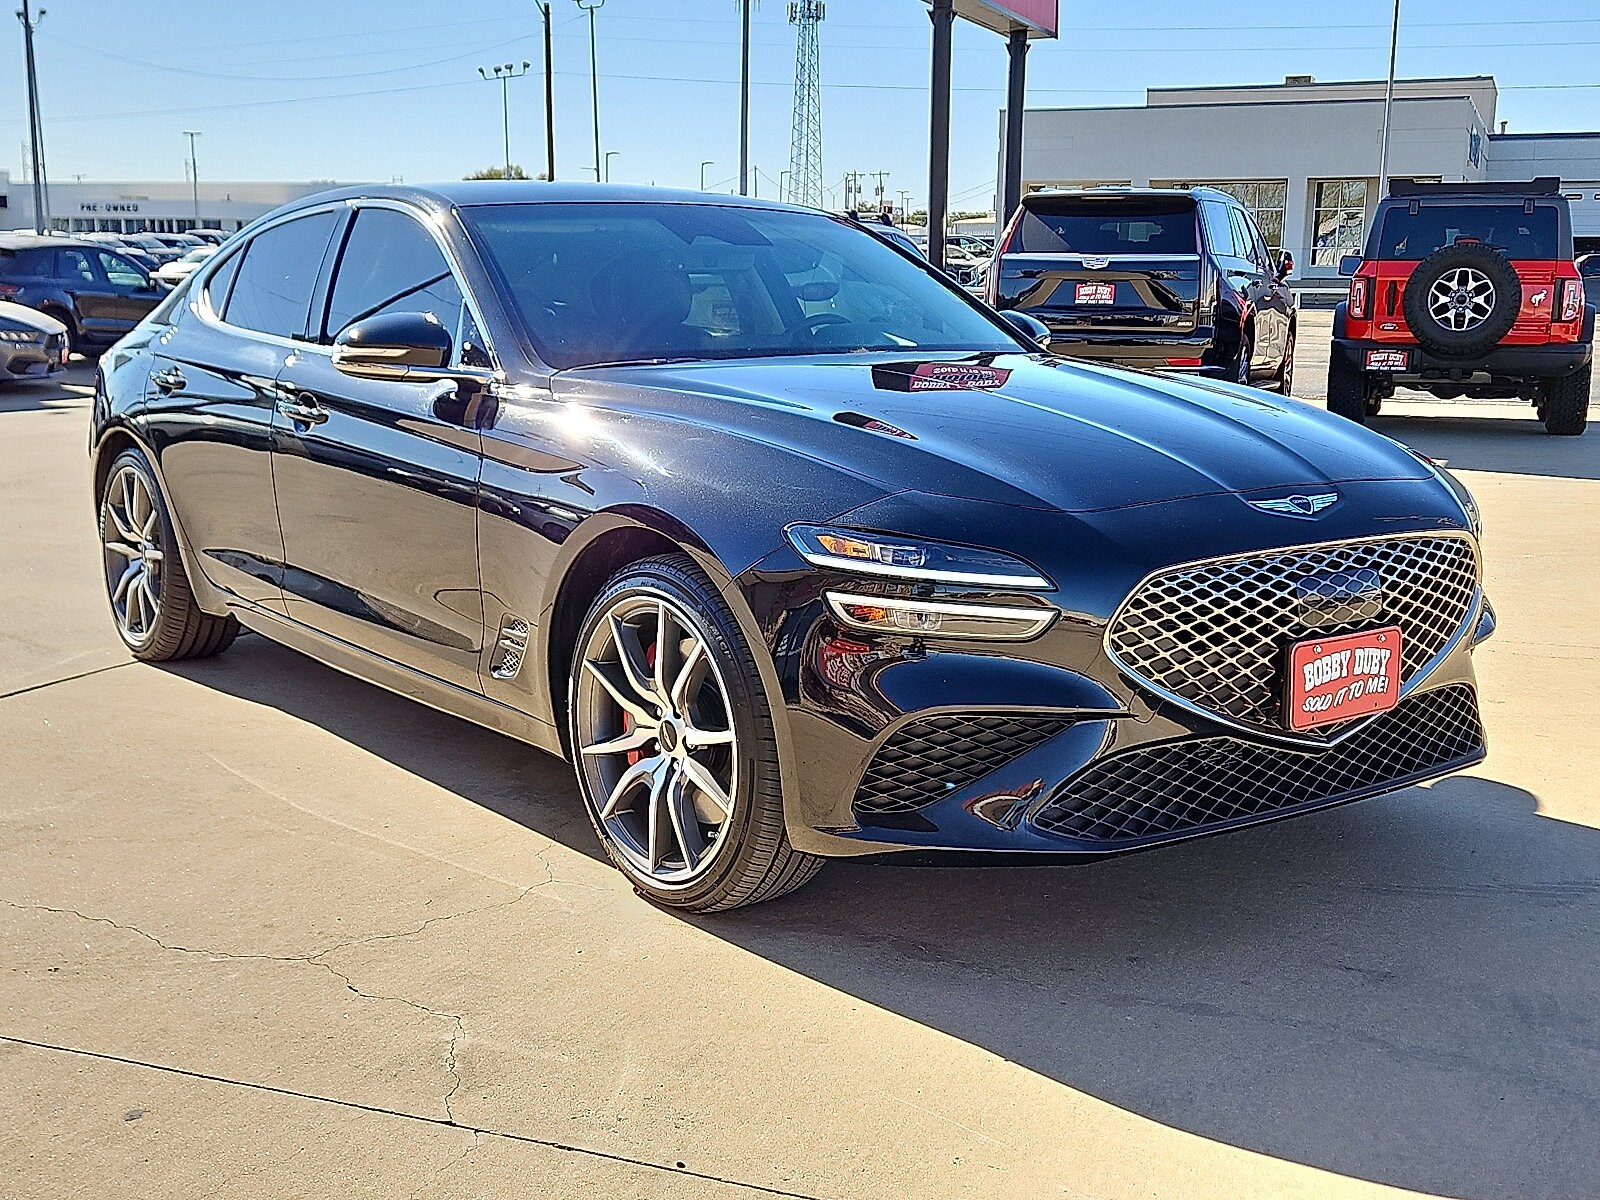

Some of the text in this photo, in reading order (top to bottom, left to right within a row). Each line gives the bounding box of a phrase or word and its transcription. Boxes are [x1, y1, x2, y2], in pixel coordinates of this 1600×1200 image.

[1303, 647, 1391, 692] BOBBY DUBY
[1302, 675, 1389, 713] SOLD IT TO ME!
